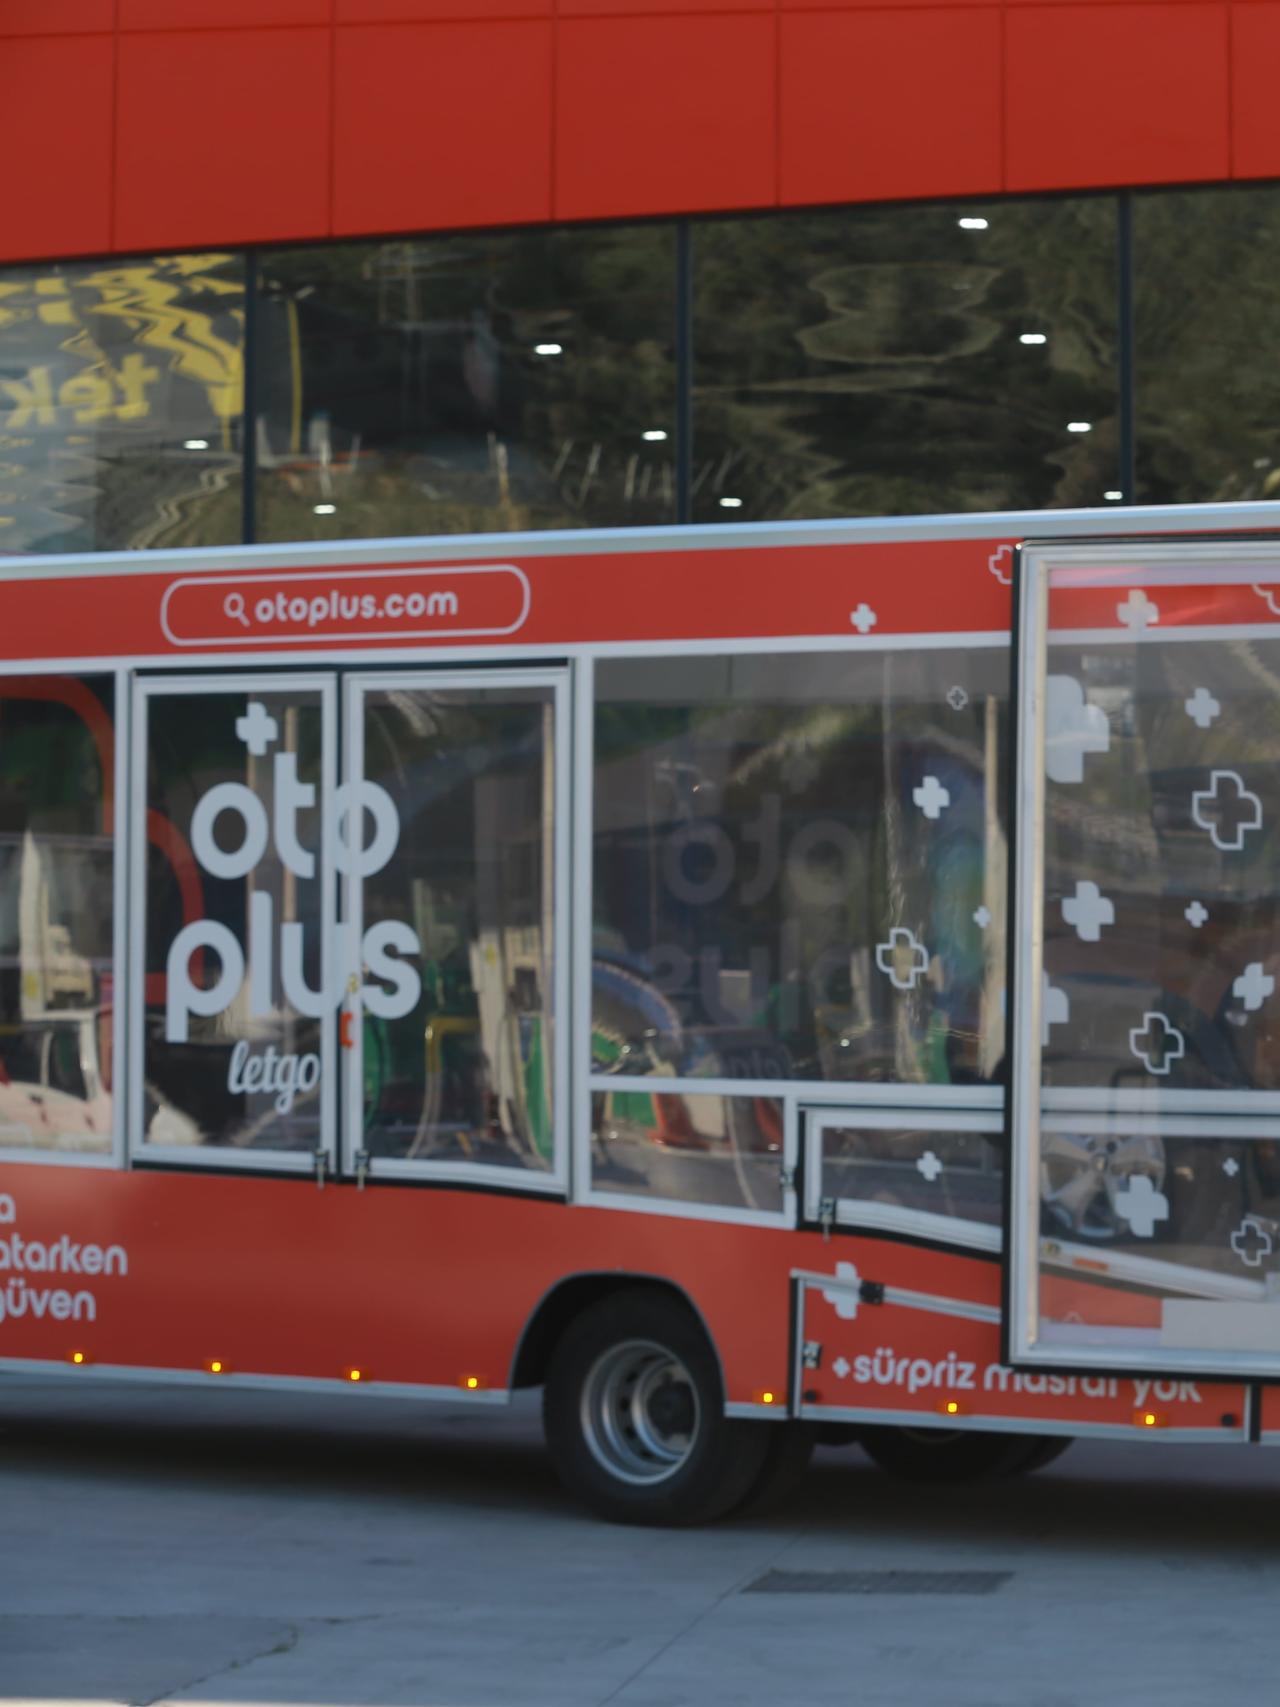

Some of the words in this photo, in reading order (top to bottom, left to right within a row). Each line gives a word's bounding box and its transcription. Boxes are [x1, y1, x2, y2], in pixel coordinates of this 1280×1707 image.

[255, 590, 458, 627] otoplus.com
[190, 752, 400, 880] oto
[166, 890, 422, 1043] plus
[227, 1040, 320, 1115] letgo
[0, 1277, 97, 1324] üven
